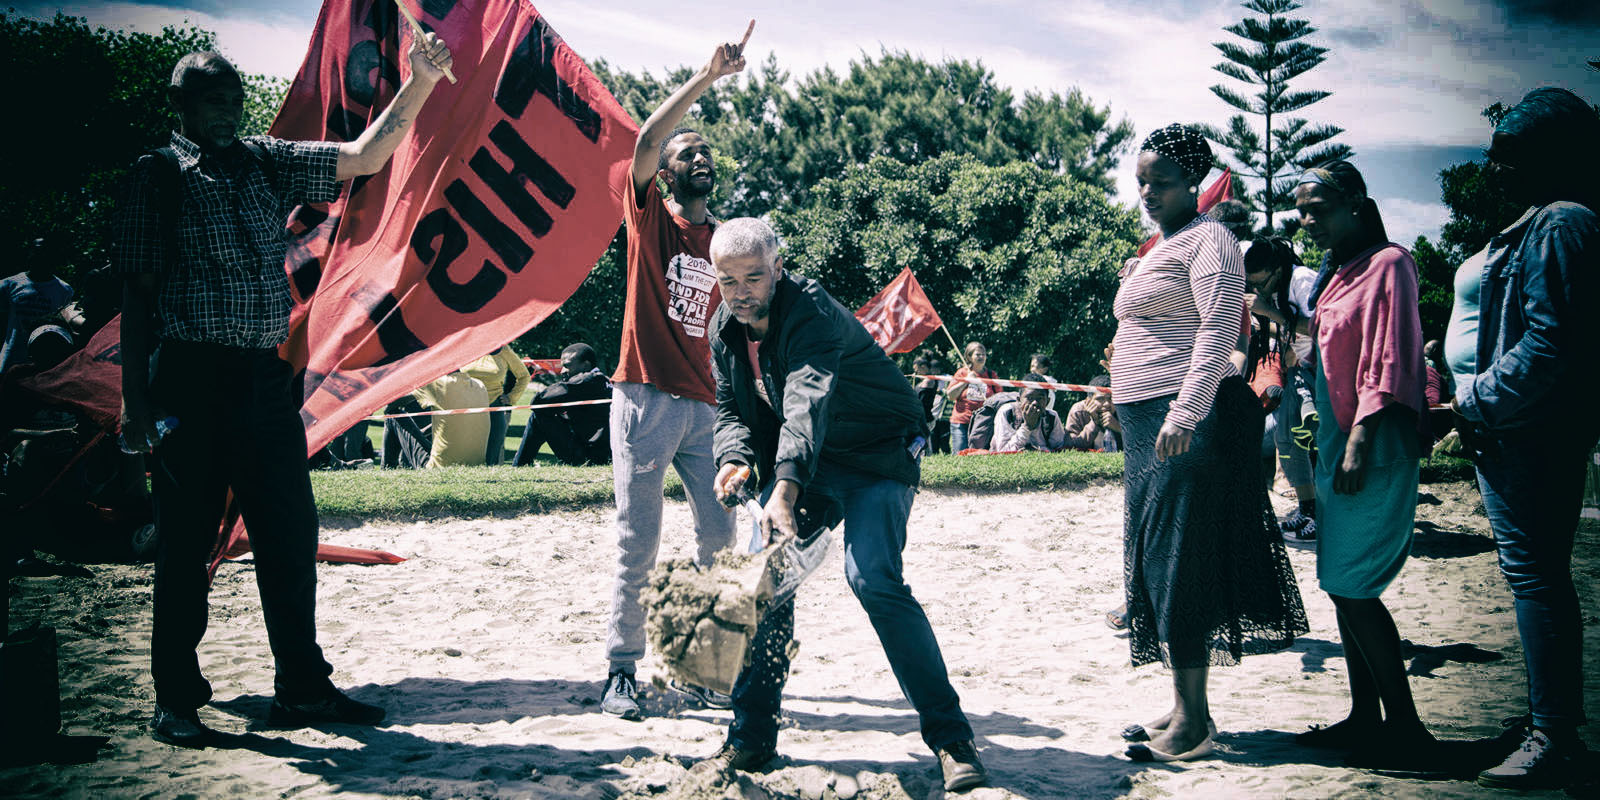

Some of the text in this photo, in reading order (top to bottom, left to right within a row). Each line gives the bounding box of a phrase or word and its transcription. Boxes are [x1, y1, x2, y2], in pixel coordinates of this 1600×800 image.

[687, 257, 707, 271] 2018
[667, 281, 710, 305] AND FOR
